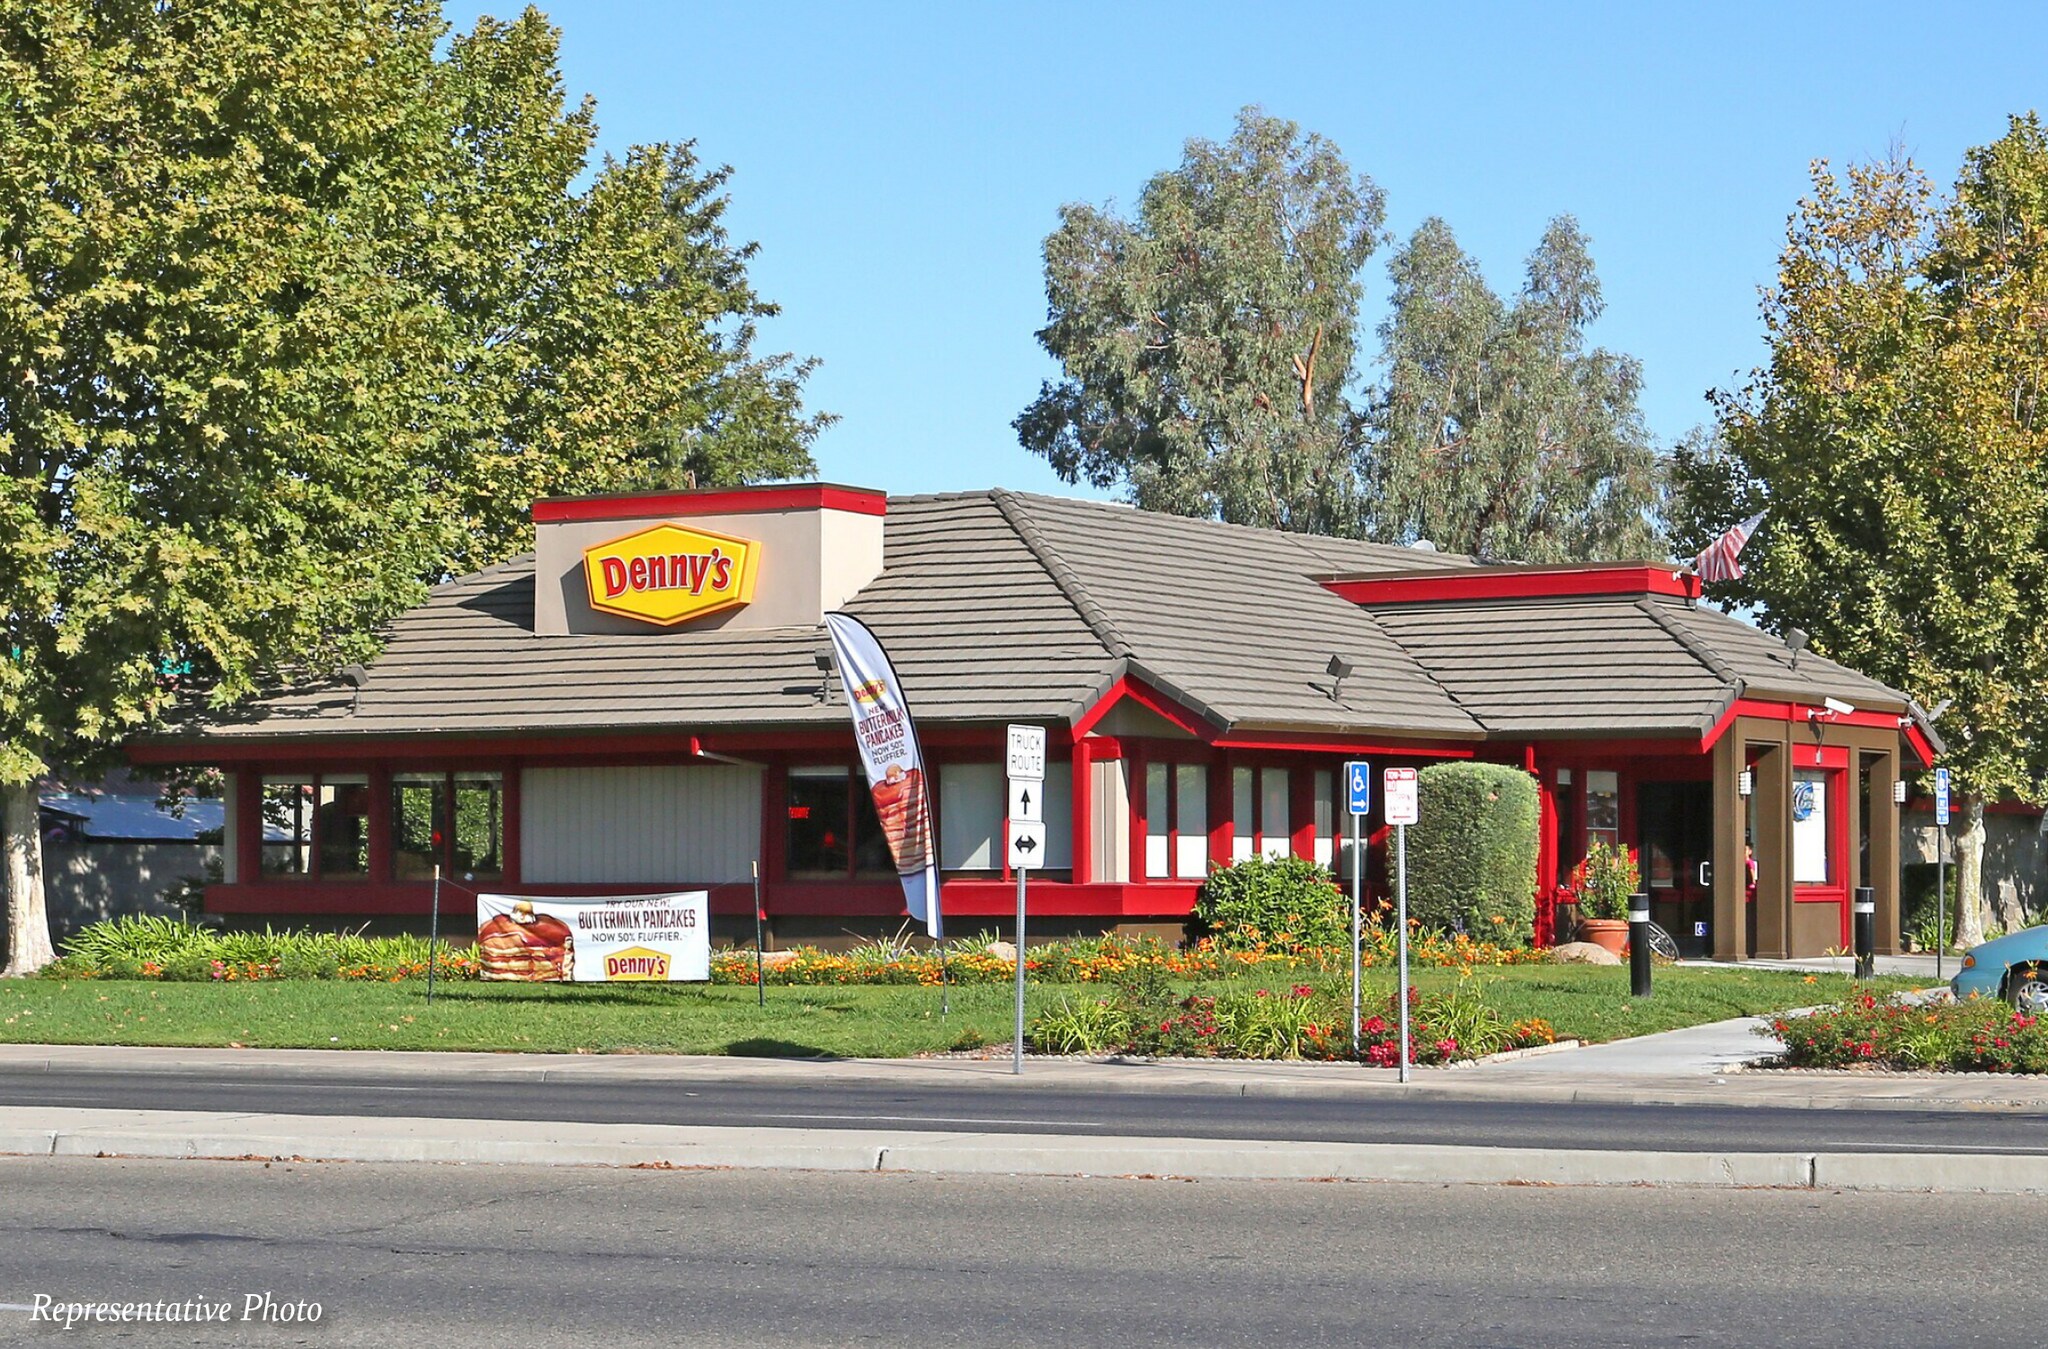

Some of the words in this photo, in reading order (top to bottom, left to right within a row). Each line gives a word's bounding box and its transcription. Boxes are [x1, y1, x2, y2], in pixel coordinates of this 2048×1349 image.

[600, 547, 733, 599] Denny's
[865, 723, 904, 748] PANCAKES
[1011, 733, 1041, 750] TRUCK
[871, 744, 889, 757] NOW
[890, 741, 905, 751] 50%
[1011, 755, 1041, 771] ROUTE
[606, 899, 623, 908] TRY
[624, 899, 645, 908] OUR
[578, 911, 640, 929] BUTTERMILK
[643, 909, 696, 928] PANCAKES
[592, 932, 616, 942] NOW
[618, 932, 636, 942] 50%
[607, 955, 667, 977] Denny's
